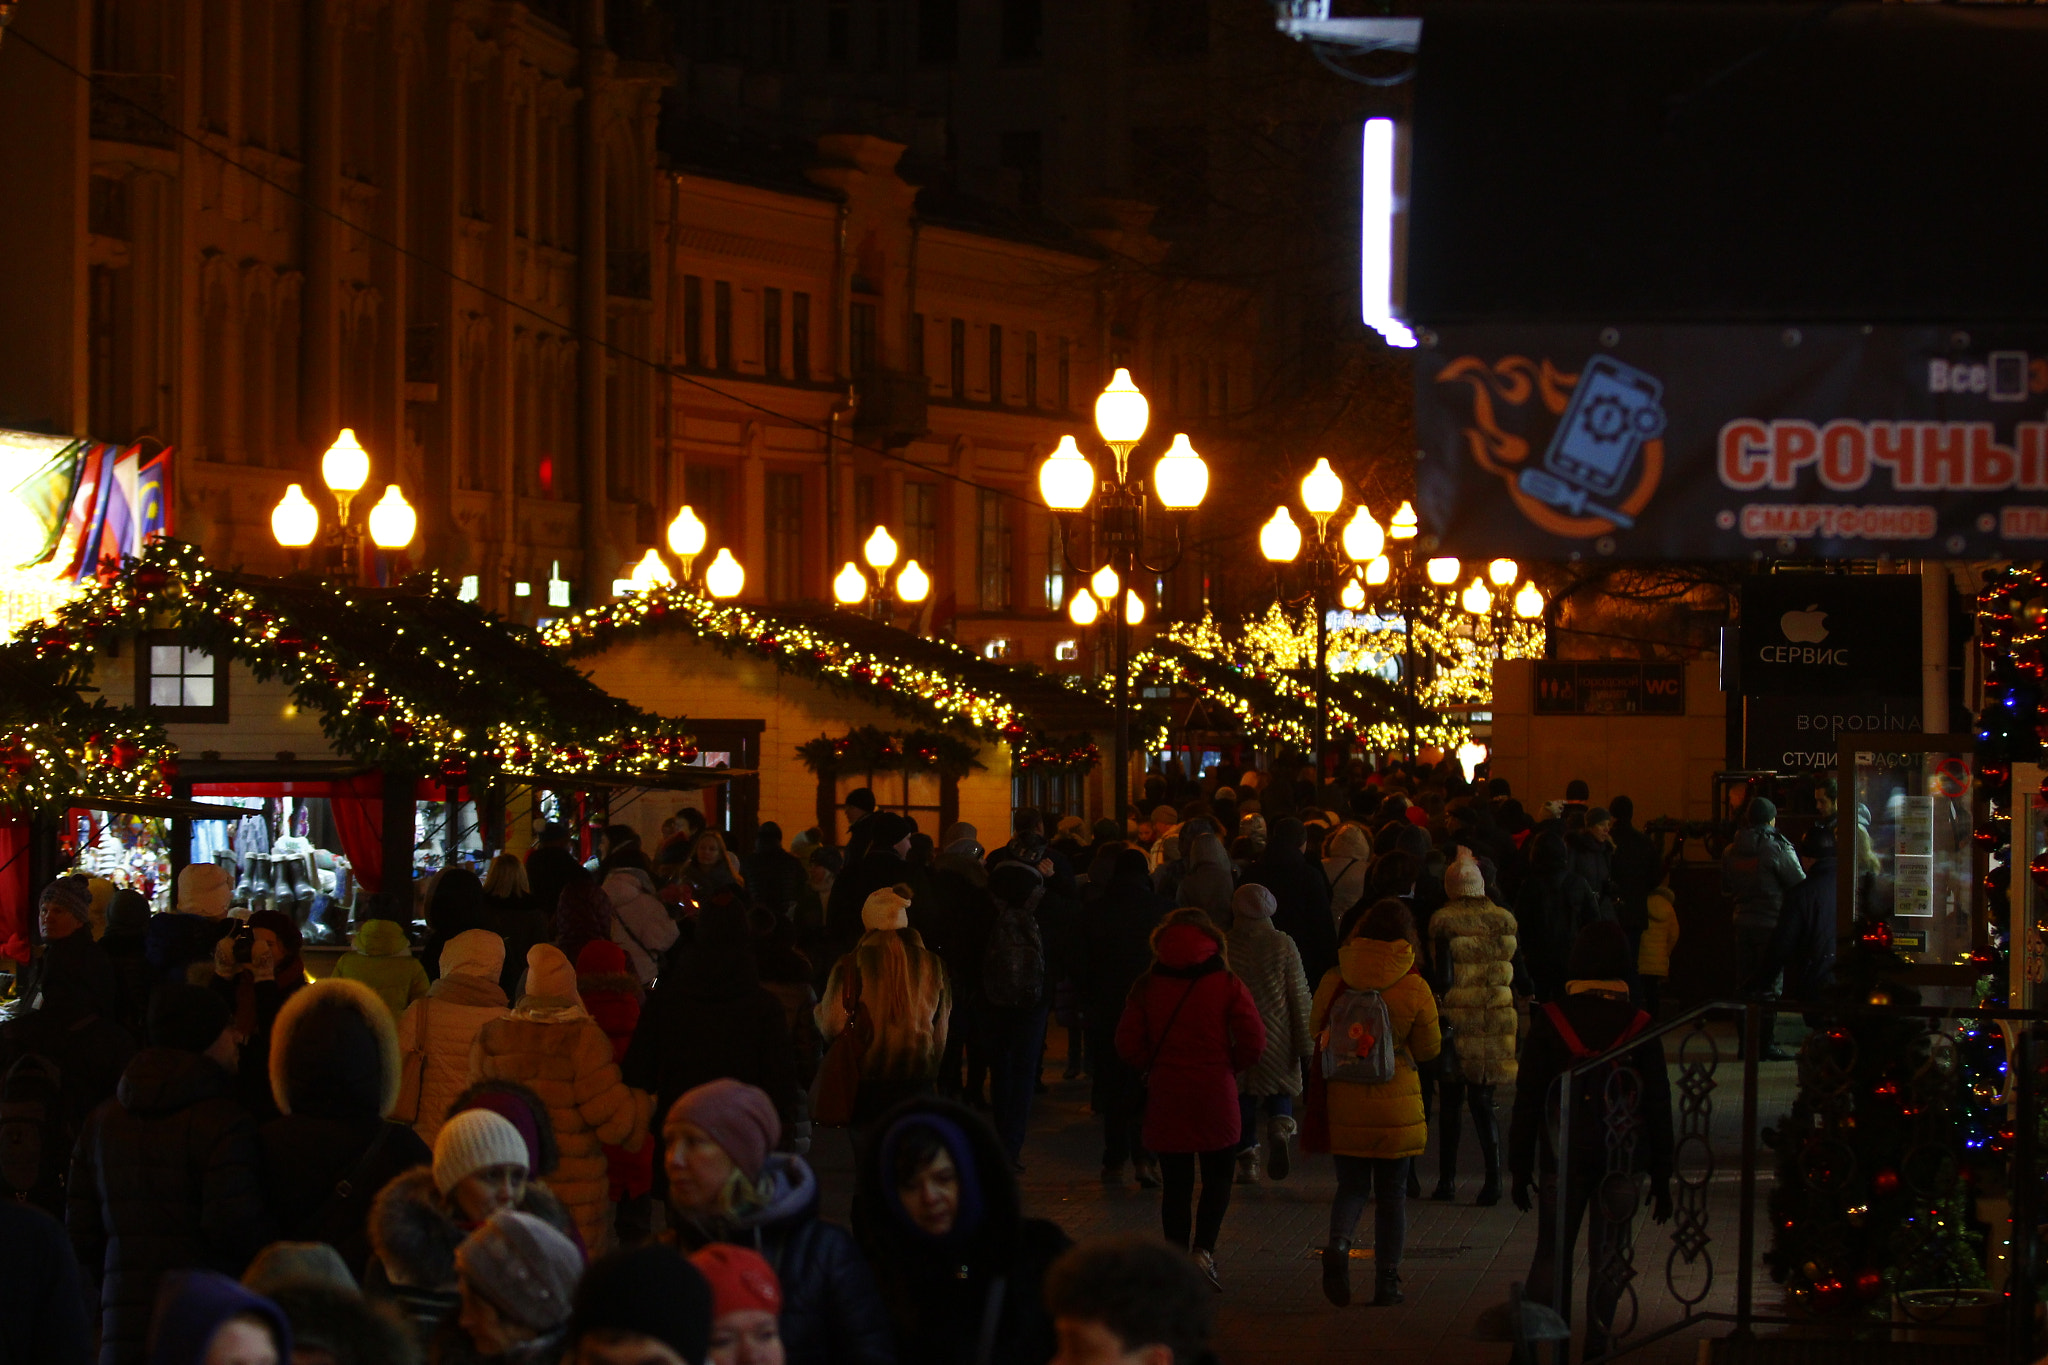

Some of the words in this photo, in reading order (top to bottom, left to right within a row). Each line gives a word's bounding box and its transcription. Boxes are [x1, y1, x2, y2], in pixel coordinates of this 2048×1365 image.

[1928, 357, 1987, 394] Все
[1718, 418, 2048, 490] СРОЧНЫ
[1741, 504, 1938, 539] СМАРТФОНОВ
[2001, 505, 2048, 540] ПЛ
[1759, 645, 1849, 666] СЕРВИС
[1645, 679, 1681, 695] WC
[1782, 751, 1839, 768] СТУДИ
